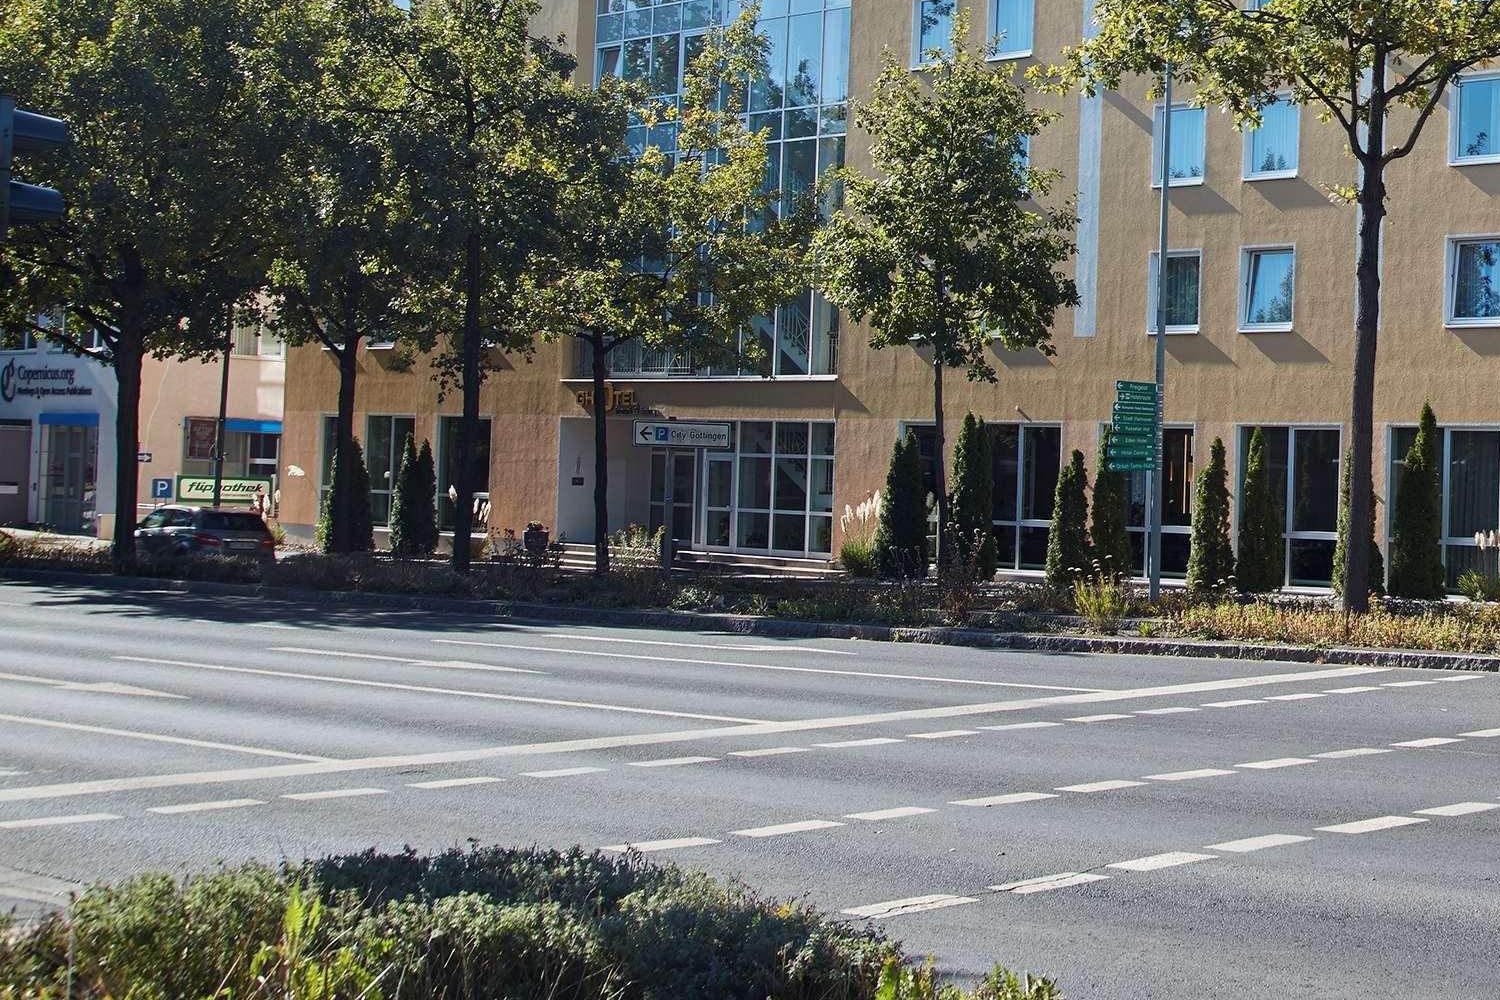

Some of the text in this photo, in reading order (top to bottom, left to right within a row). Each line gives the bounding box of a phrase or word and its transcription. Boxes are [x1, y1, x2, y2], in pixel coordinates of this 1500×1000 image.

[17, 364, 75, 384] Copernicus.org
[671, 430, 686, 440] City
[187, 481, 263, 493] flipothek
